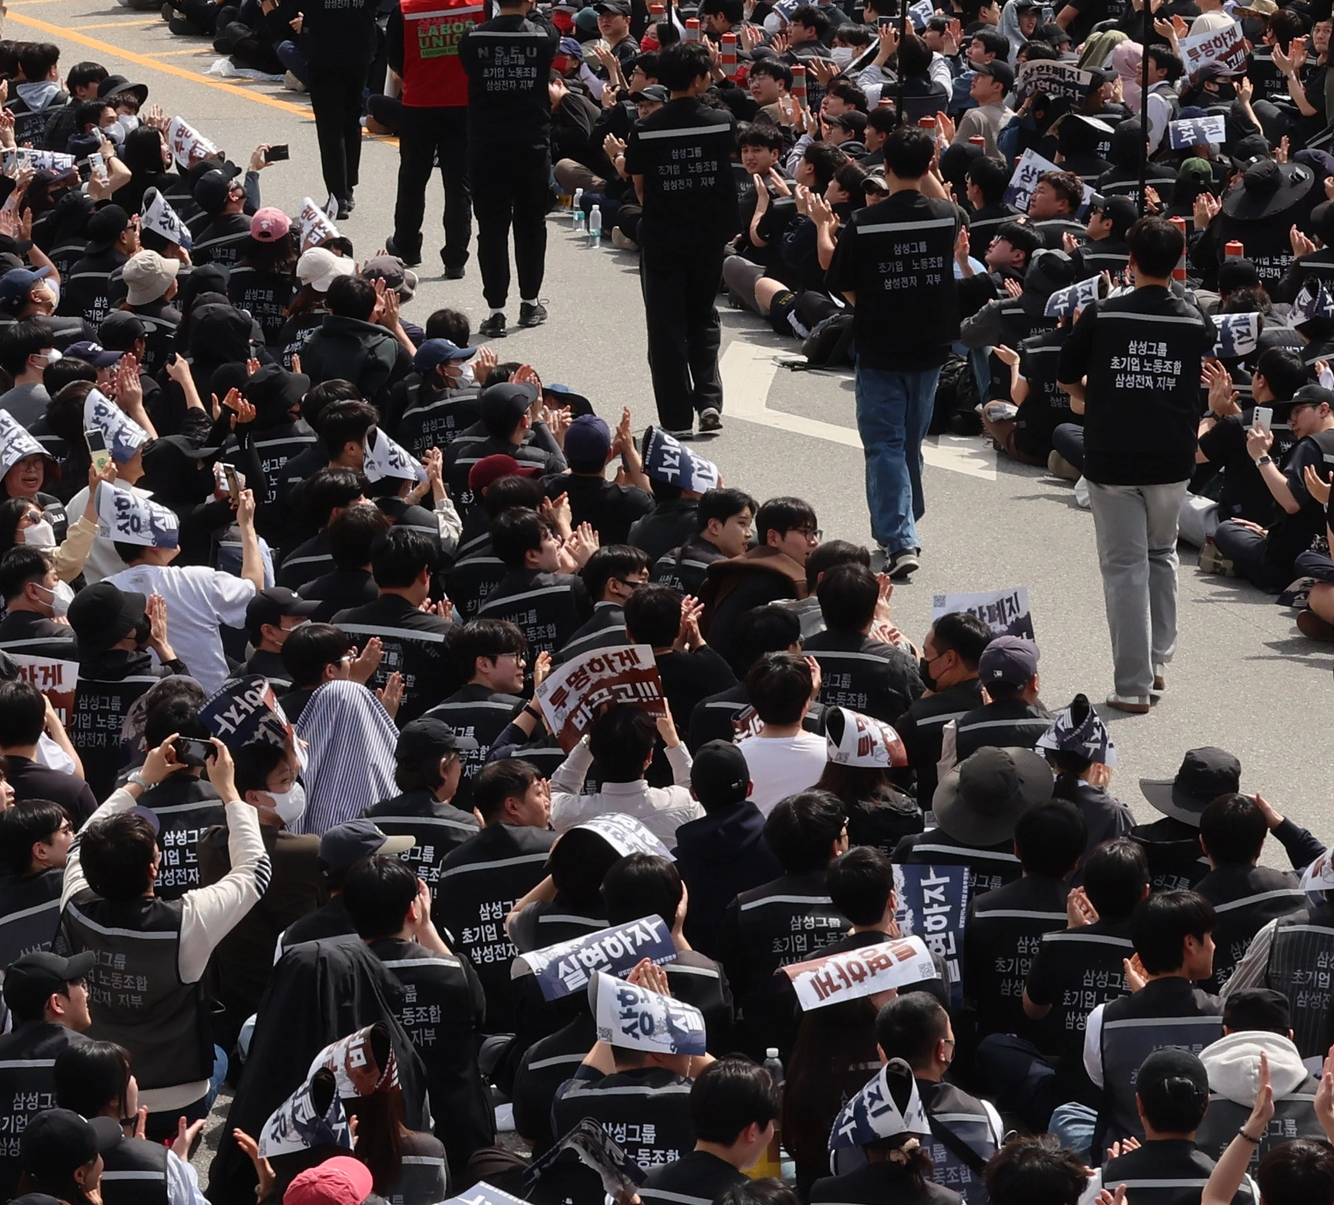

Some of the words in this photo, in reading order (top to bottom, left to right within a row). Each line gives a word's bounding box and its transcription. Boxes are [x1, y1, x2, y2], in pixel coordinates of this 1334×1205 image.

[418, 20, 475, 38] LABOR
[419, 35, 463, 50] UNIO
[1186, 26, 1239, 63] 투명하게
[482, 67, 504, 79] 초기업
[509, 67, 538, 79] 노동조합
[1019, 63, 1083, 84] 상한폐지
[487, 79, 516, 92] 삼성전자
[671, 147, 702, 160] 삼성그룹
[657, 164, 681, 176] 초기업
[688, 161, 718, 174] 노동조합
[663, 178, 693, 191] 삼성전자
[700, 175, 716, 188] 지부
[894, 241, 928, 256] 삼성그룹
[878, 261, 904, 274] 초기업
[912, 257, 944, 271] 노동조합
[883, 276, 918, 291] 삼성전자
[926, 274, 942, 287] 지부
[244, 289, 274, 301] 삼성그룹
[1128, 339, 1168, 357] 삼성그룹
[1110, 356, 1140, 372] 초기업
[1143, 358, 1183, 375] 노동조합
[1114, 373, 1153, 389] 삼성전자
[1156, 374, 1177, 391] 지부
[421, 416, 454, 433] 삼성그룹
[654, 432, 680, 482] 하자
[24, 664, 63, 687] 하게
[548, 647, 639, 712] 투명하게
[78, 694, 122, 711] 삼성그룹
[827, 691, 868, 708] 노동조합
[210, 687, 263, 737] 하자
[789, 915, 841, 931] 삼성그룹
[461, 923, 498, 944] 초기업
[772, 933, 807, 954] 초기업
[471, 943, 520, 966] 삼성전자
[552, 917, 662, 992] 실현하자
[995, 957, 1032, 975] 초기업
[98, 972, 148, 992] 노동조합
[1291, 970, 1330, 990] 초기업
[123, 994, 144, 1008] 지부
[1062, 989, 1097, 1009] 초기업
